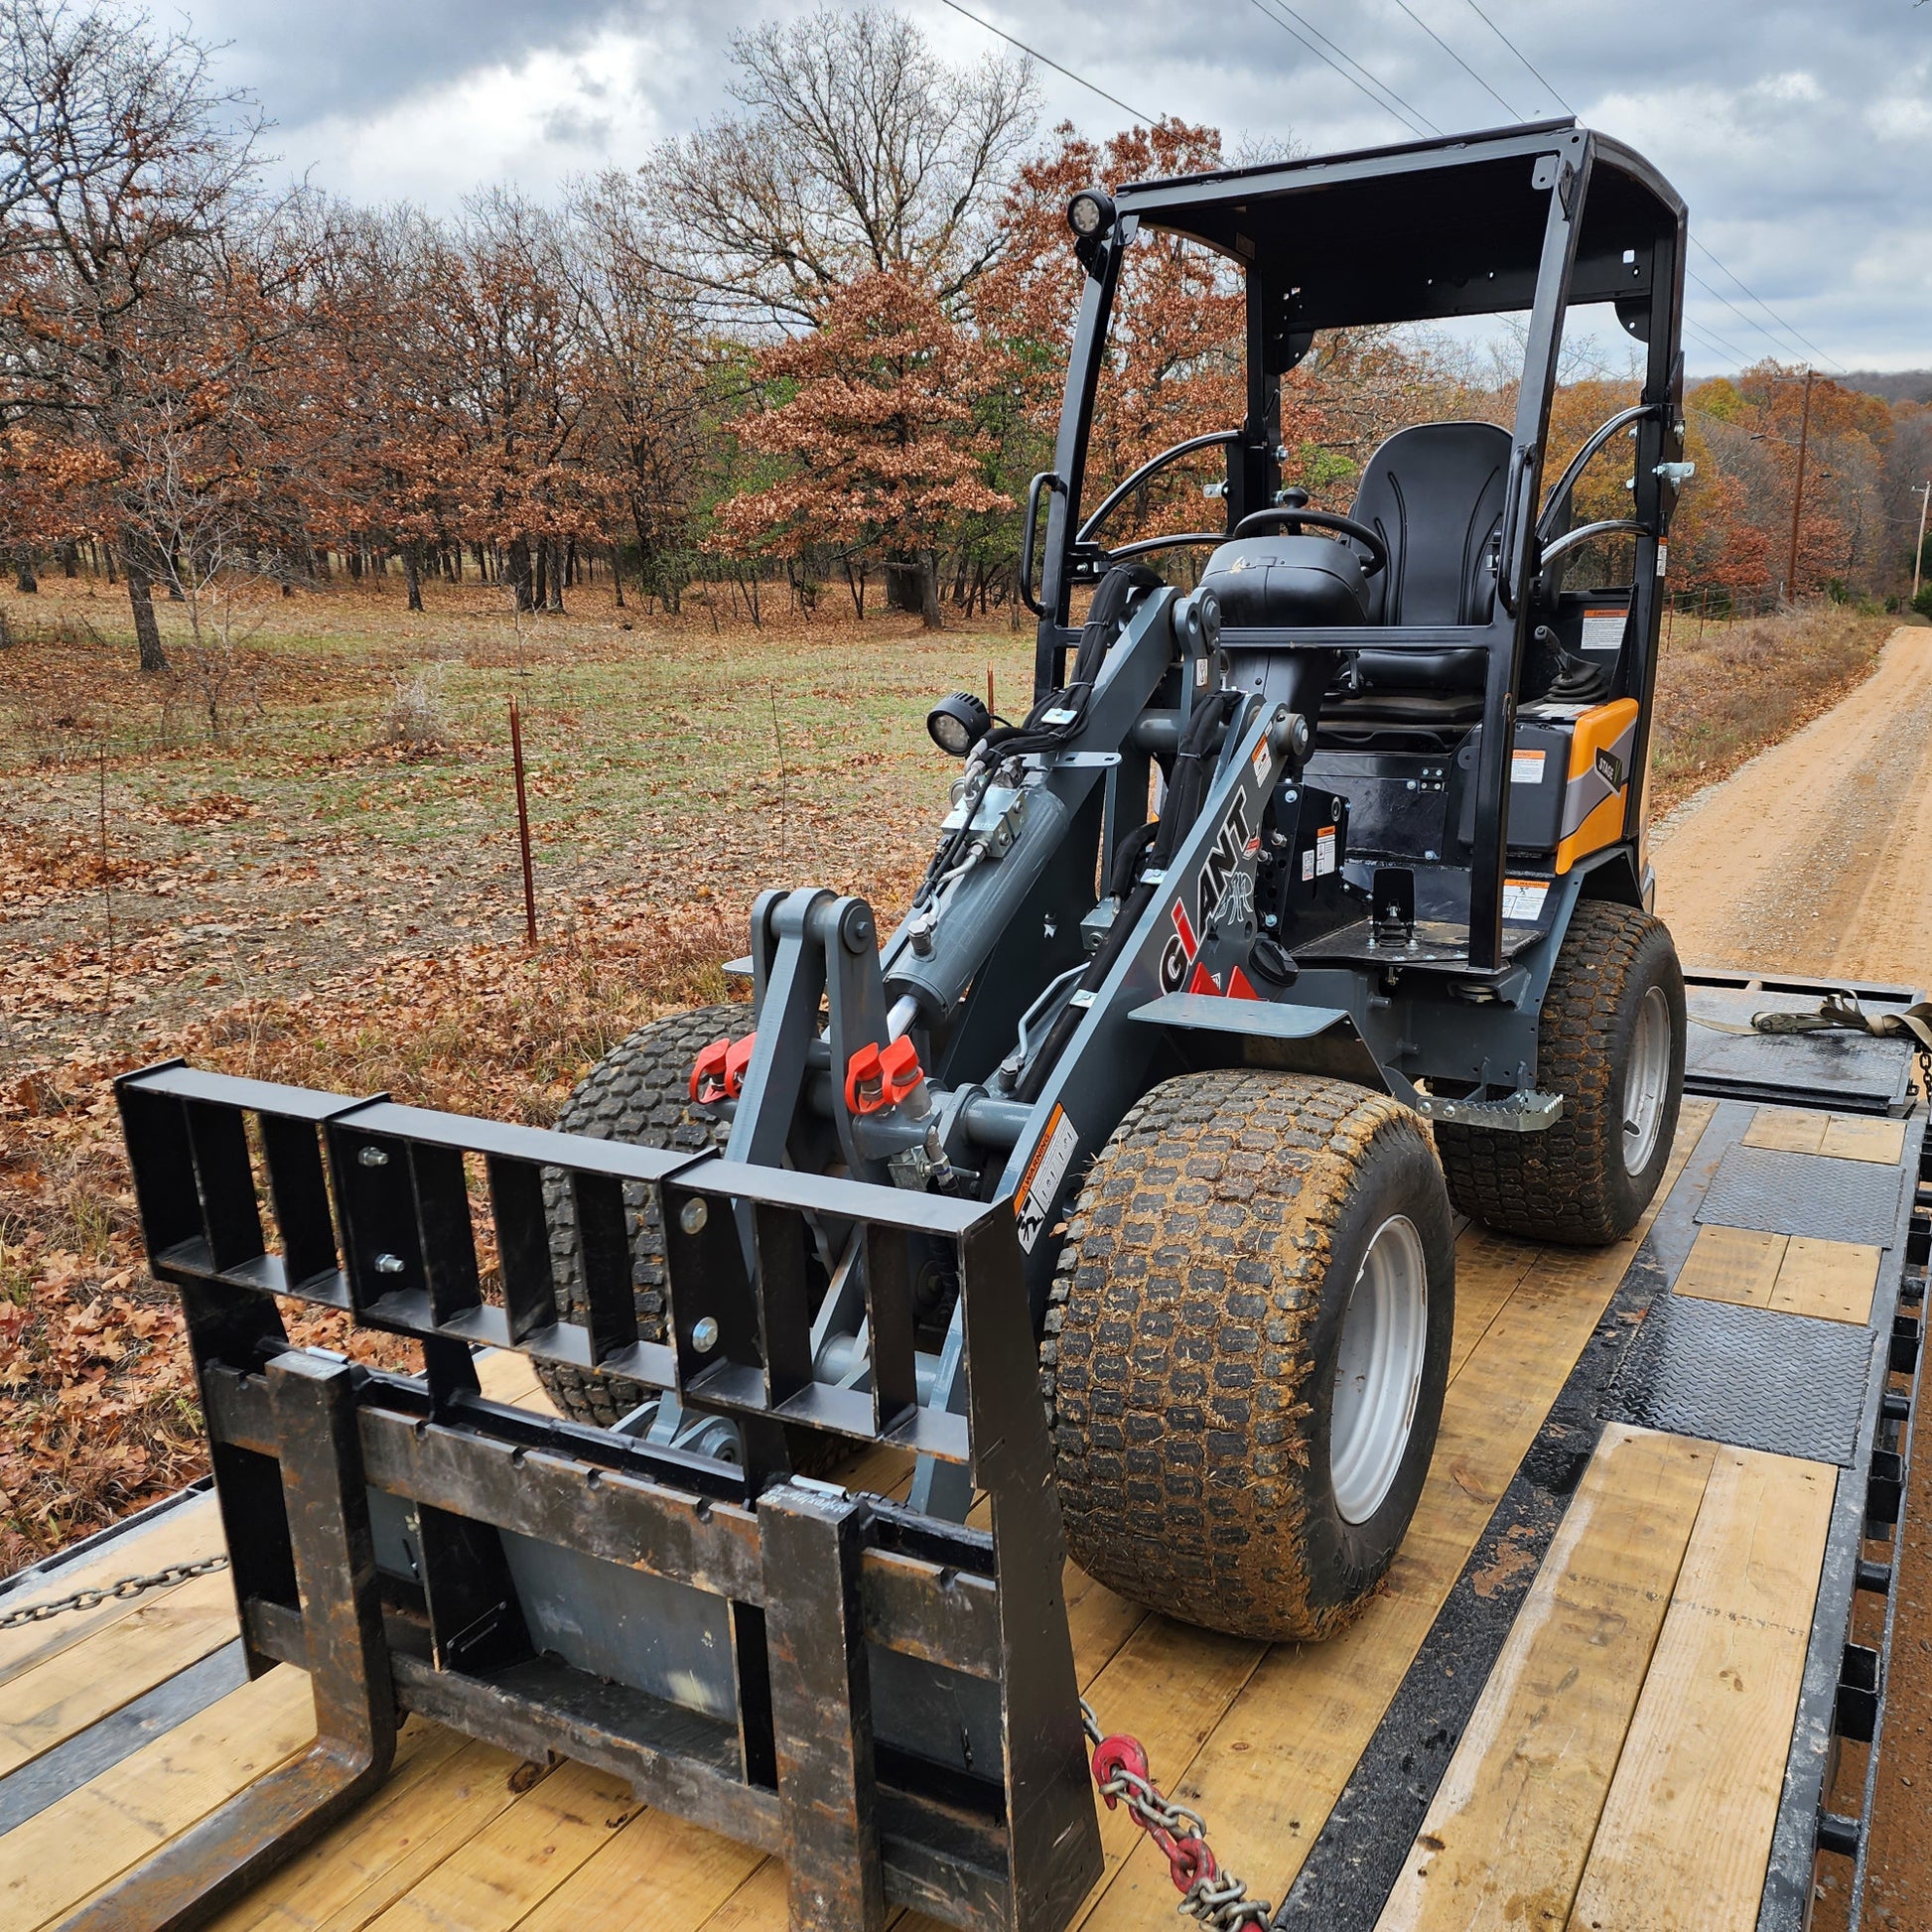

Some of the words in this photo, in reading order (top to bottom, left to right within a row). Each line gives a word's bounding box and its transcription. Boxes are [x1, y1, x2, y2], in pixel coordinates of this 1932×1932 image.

[1598, 758, 1613, 780] STAGE
[1160, 784, 1250, 996] GIANT
[1024, 1134, 1050, 1186] WARNING
